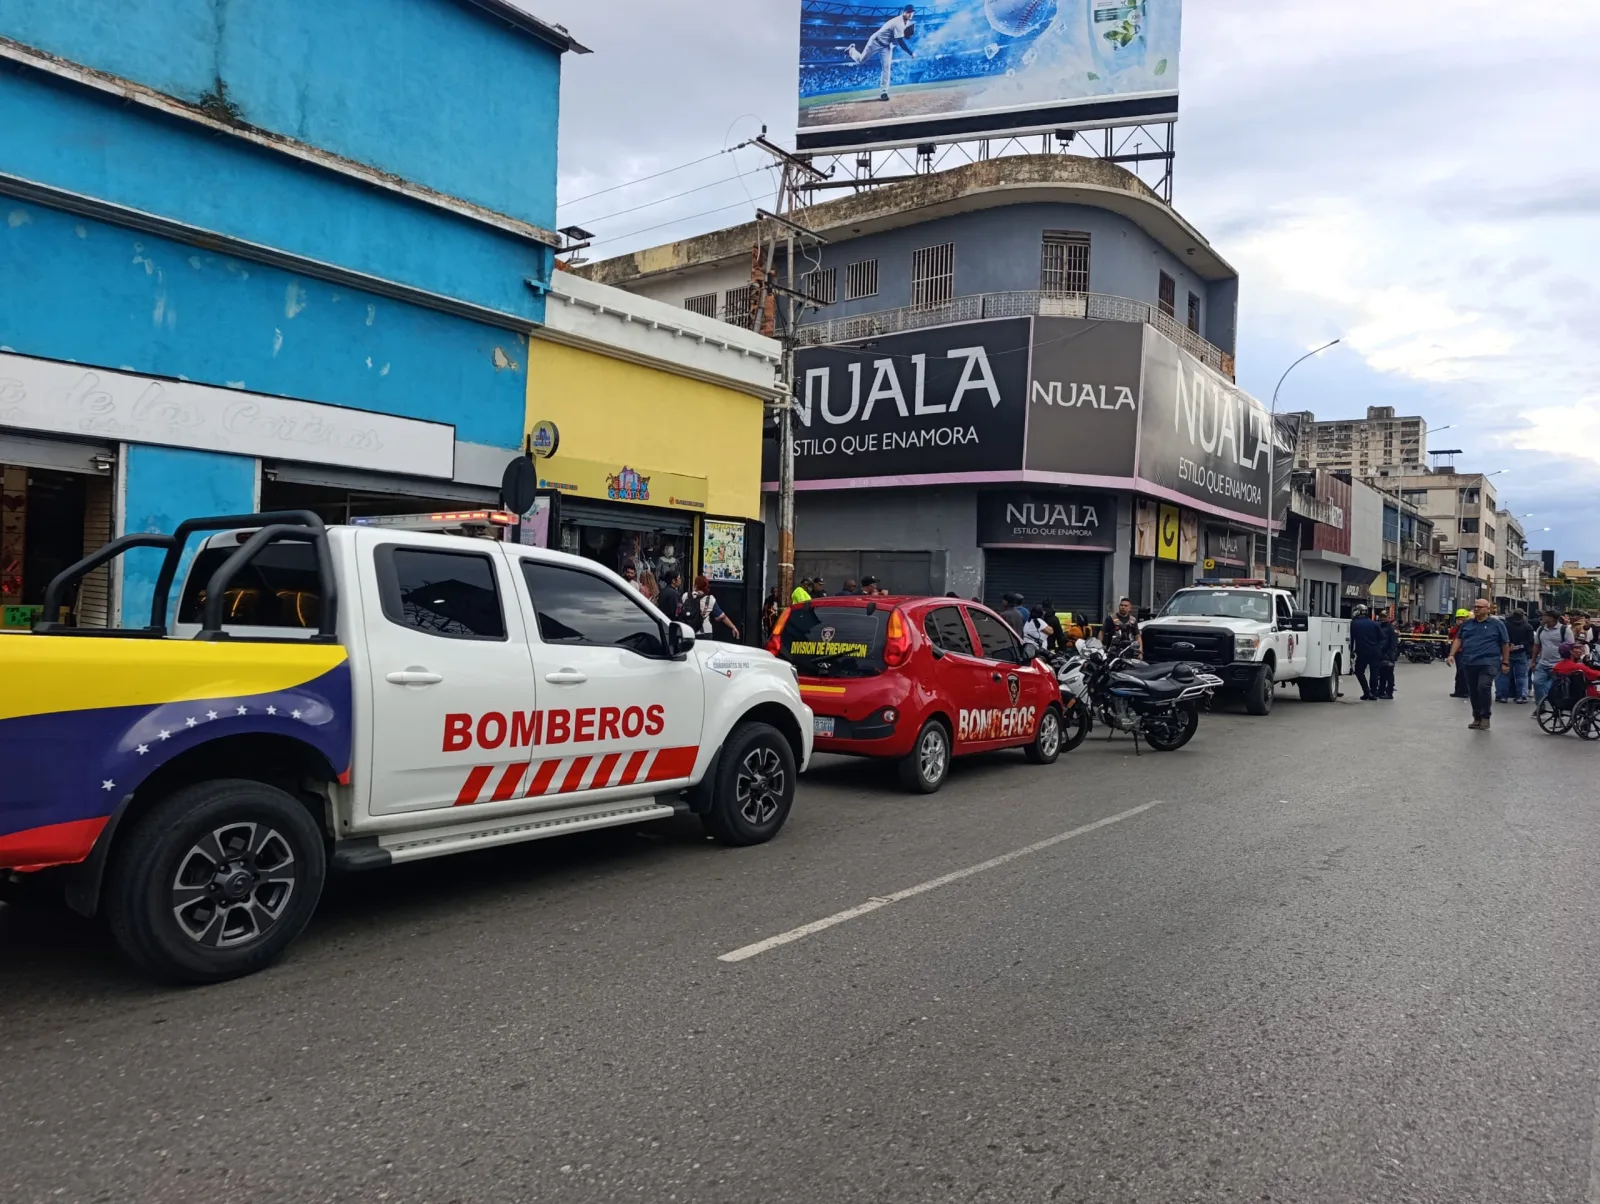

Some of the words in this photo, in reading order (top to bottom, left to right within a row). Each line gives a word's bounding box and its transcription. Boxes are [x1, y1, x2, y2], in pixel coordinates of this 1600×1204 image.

[793, 346, 1001, 427] NUALA
[1031, 380, 1136, 411] NUALA
[1173, 359, 1272, 474] NUALA
[793, 437, 836, 457] STILO
[841, 433, 878, 455] QUE
[882, 425, 979, 450] ENAMORA
[1178, 457, 1206, 487] ESTILO
[1206, 470, 1224, 494] QUE
[1225, 477, 1262, 505] ENAMORA
[1006, 503, 1099, 527] NUALA
[1013, 527, 1038, 535] ESTILO
[1039, 527, 1057, 536] QUE
[1057, 528, 1093, 537] ENAMORA
[790, 641, 816, 655] DIVISION
[816, 642, 827, 655] DE
[442, 703, 665, 752] BOMBEROS
[957, 705, 1036, 741] BOMBEROS
